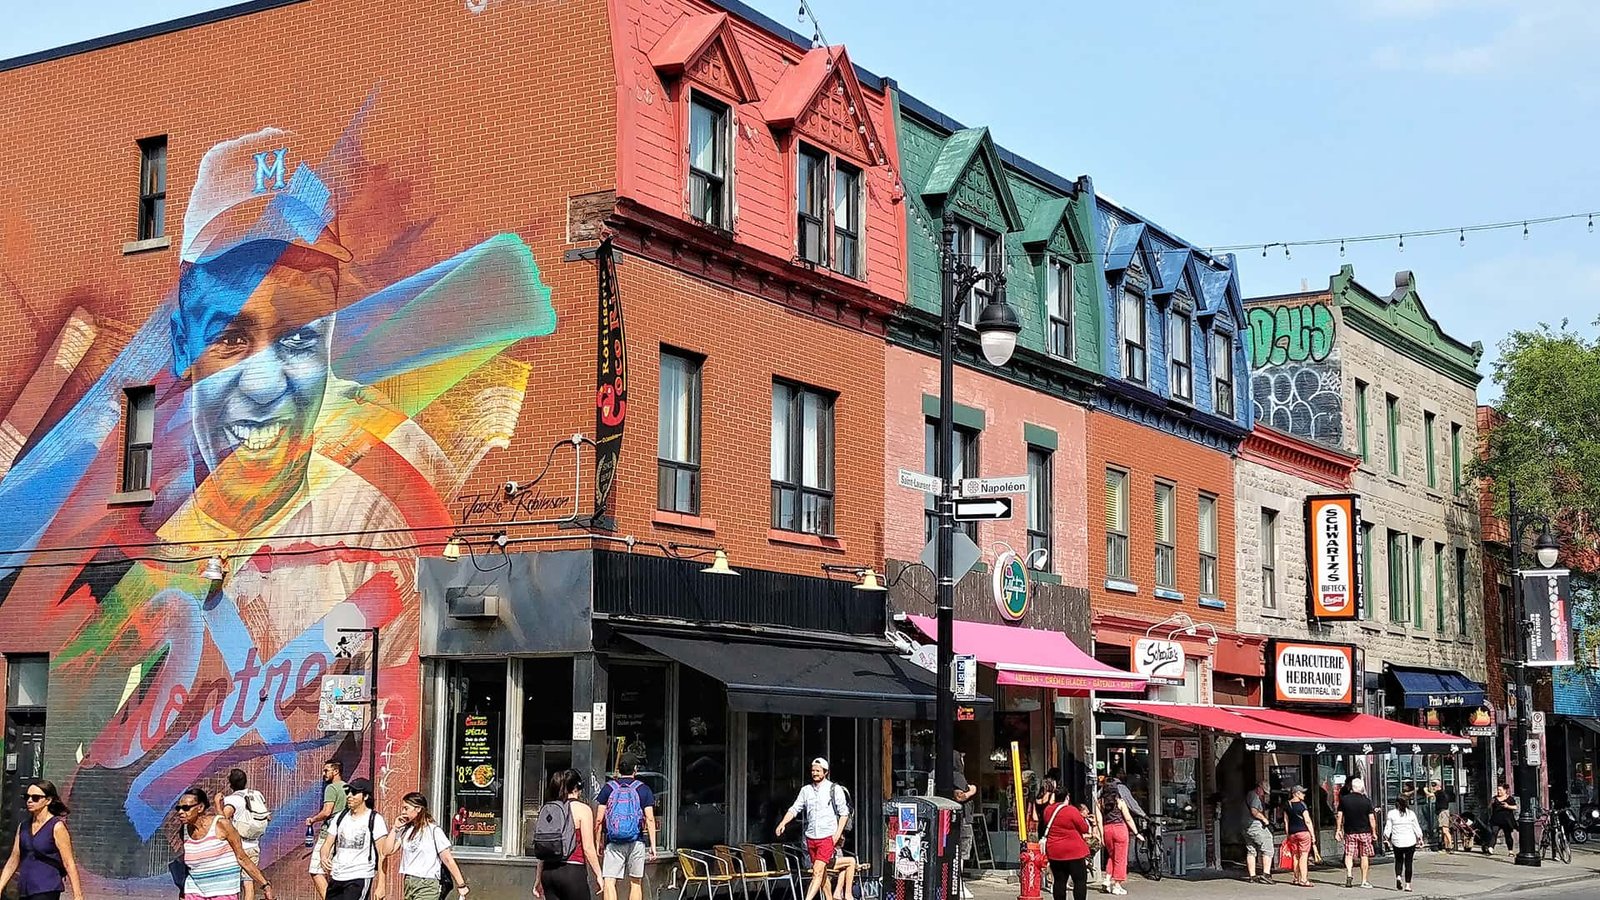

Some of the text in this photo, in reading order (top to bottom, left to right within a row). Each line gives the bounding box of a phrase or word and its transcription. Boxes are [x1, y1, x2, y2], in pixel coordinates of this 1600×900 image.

[900, 474, 931, 490] Saint-Laurent
[981, 483, 1026, 494] Napoléon
[458, 485, 569, 524] Jackie Robinson
[1325, 508, 1340, 582] SCHWARTZ'S
[1321, 584, 1347, 592] BIFTECK
[1282, 653, 1344, 669] CHARCUTERIE
[1286, 670, 1342, 687] HEBRAIQUE
[1288, 686, 1296, 694] DE
[465, 727, 488, 736] SPÉCIAL
